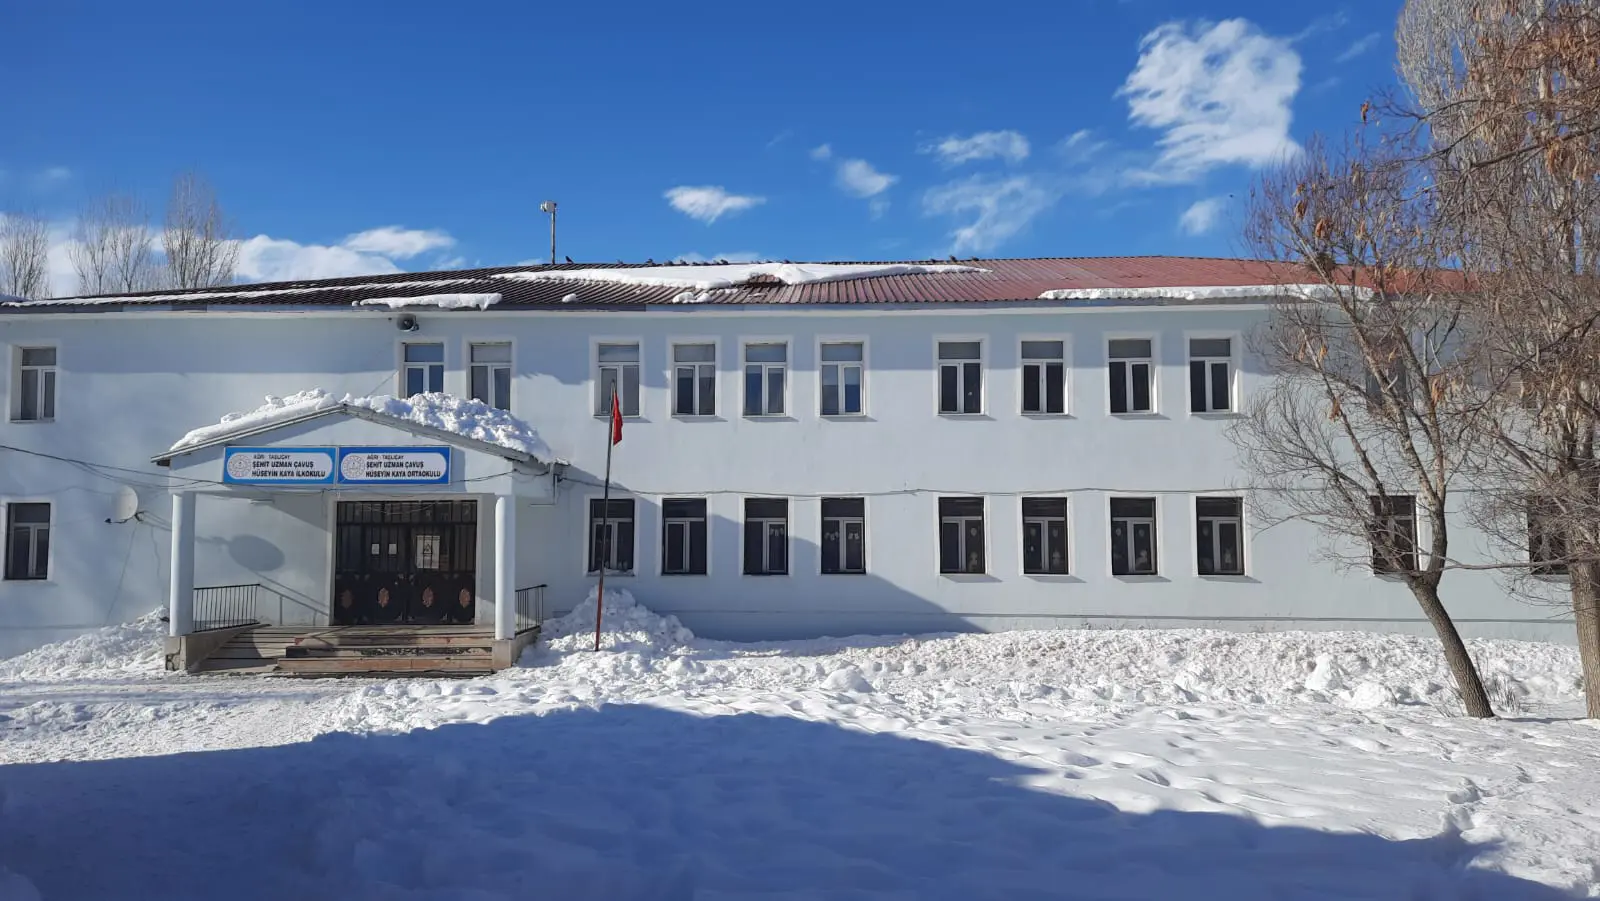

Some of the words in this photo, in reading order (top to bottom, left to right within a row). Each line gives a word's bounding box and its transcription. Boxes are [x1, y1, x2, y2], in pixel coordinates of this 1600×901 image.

[294, 460, 314, 468] ÇAVUŞ
[405, 460, 424, 468] ÇAVUŞ
[279, 469, 295, 477] KAYA
[392, 469, 406, 477] KAYA
[407, 469, 441, 477] ORTAOKULU
